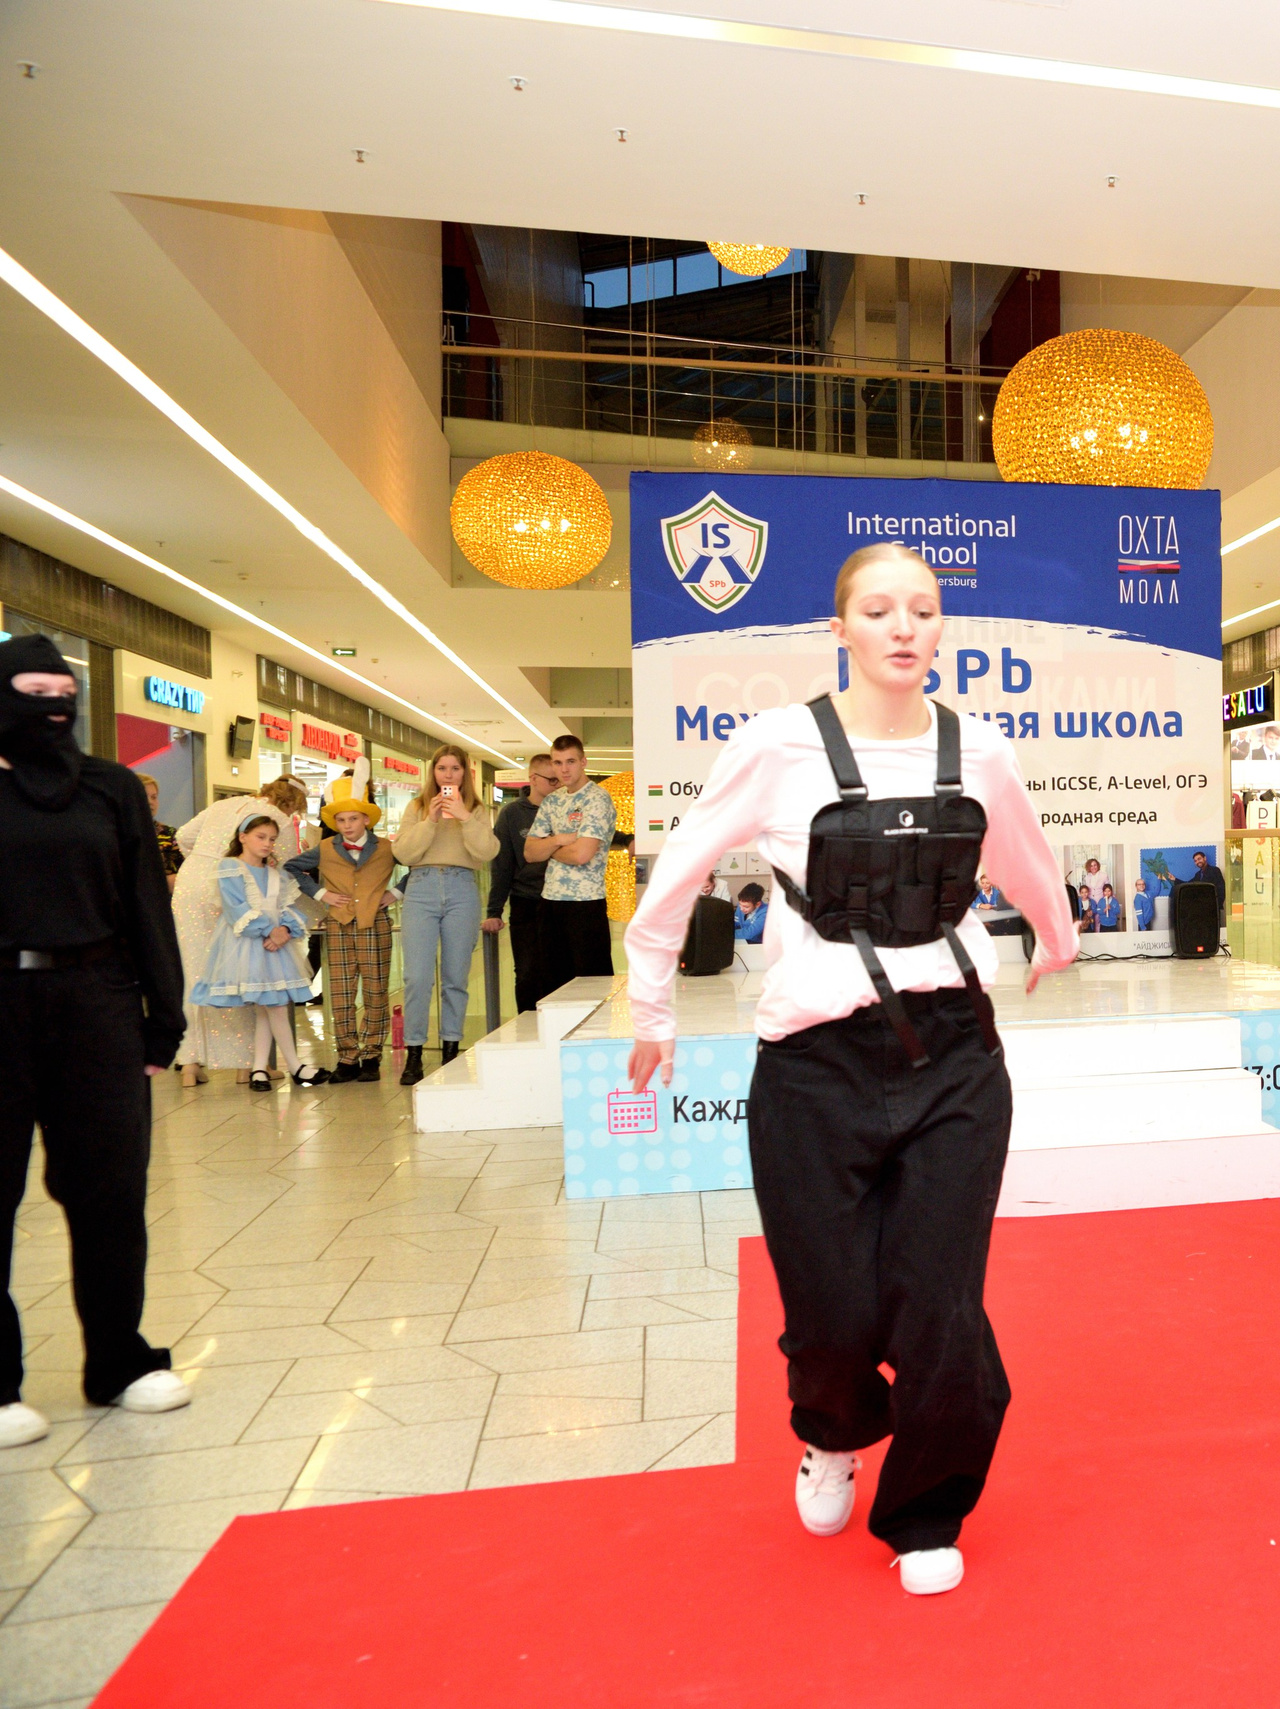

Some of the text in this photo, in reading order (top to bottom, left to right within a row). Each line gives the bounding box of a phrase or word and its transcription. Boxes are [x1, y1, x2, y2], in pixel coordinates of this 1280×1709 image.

[701, 522, 731, 549] IS
[847, 512, 1016, 538] International
[1118, 515, 1180, 555] ОХТА
[890, 540, 977, 565] hool
[709, 580, 727, 588] SPb
[1119, 579, 1180, 604] МОЛЛ
[146, 675, 184, 709] CRAZY
[1054, 711, 1184, 739] школа
[1051, 776, 1102, 792] IGCSE,
[1107, 774, 1171, 791] A-Level,
[1175, 774, 1208, 789] ОГЭ
[1108, 810, 1158, 826] среда
